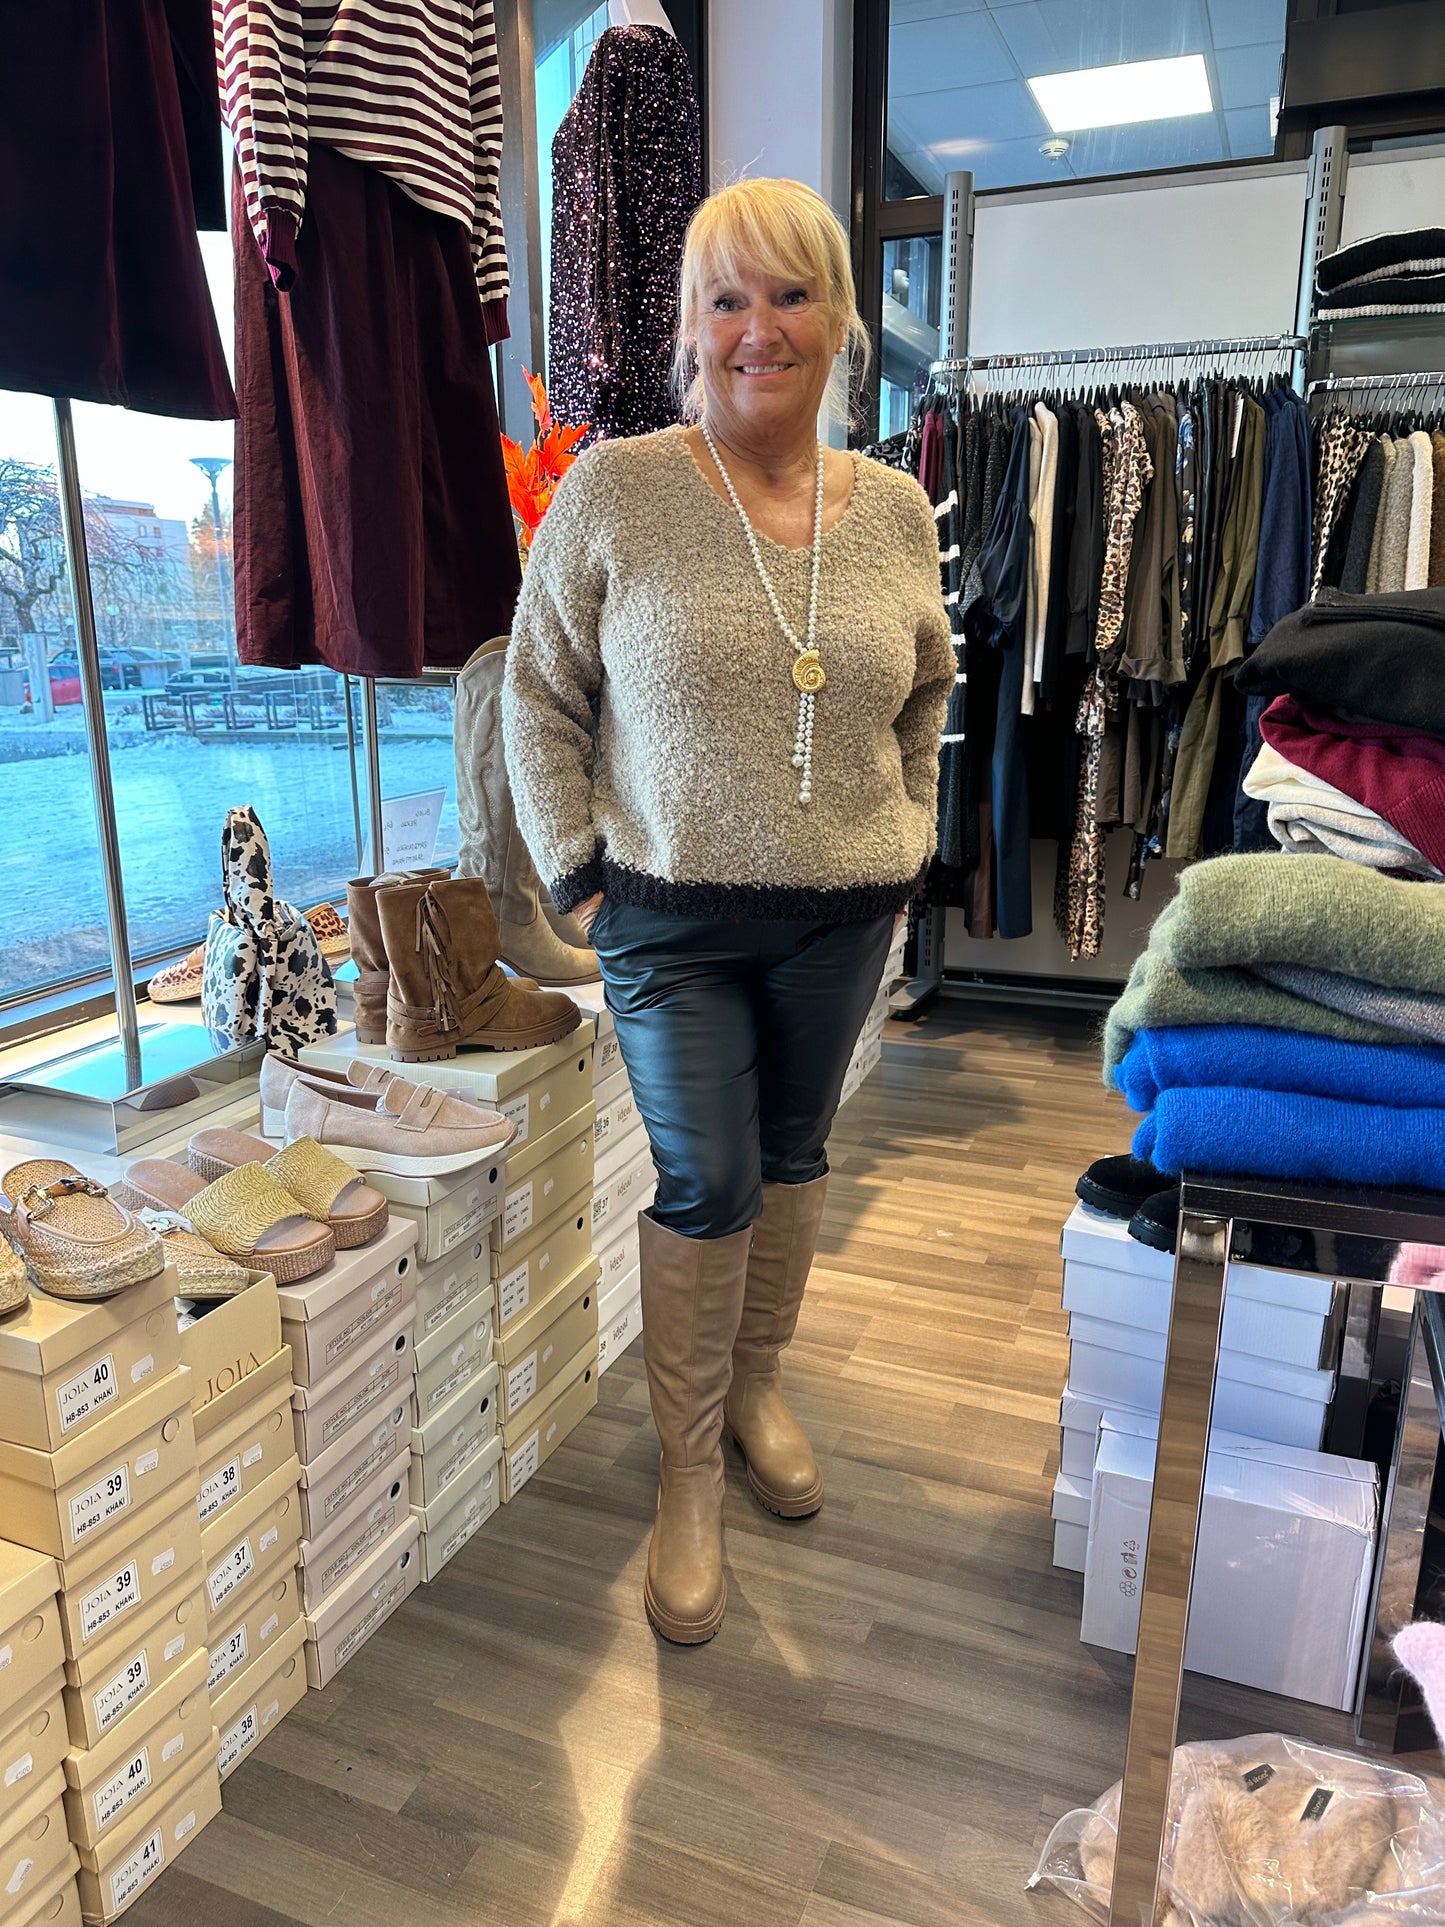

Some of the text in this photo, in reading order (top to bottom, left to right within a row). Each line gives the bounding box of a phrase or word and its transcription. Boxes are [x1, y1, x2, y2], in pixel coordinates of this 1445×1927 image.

[63, 1363, 109, 1405] JOIA 40
[204, 1351, 261, 1405] JOIA
[66, 1386, 114, 1425] H8-853 KHAKI
[75, 1474, 122, 1516] JOIA 39
[221, 1485, 238, 1502] KHAKI
[222, 1466, 236, 1485] 38
[76, 1496, 126, 1535] H8-853 KHAKI
[212, 1545, 246, 1590] JOIA 37
[215, 1562, 252, 1603] H8-853 KHAKI
[85, 1570, 132, 1614] JOIA 39
[87, 1592, 135, 1632] H8-853 KHAKI
[210, 1633, 241, 1669] OIA 37
[99, 1661, 142, 1709] JOIA 39
[102, 1679, 146, 1726] H8-853 KHAKI
[241, 1714, 253, 1734] 38
[98, 1758, 143, 1807] JOIA 40
[101, 1776, 147, 1824] H8-853 KHAKI
[115, 1838, 156, 1889] JOIA 41
[118, 1856, 160, 1904] H8-853 KHAKI
